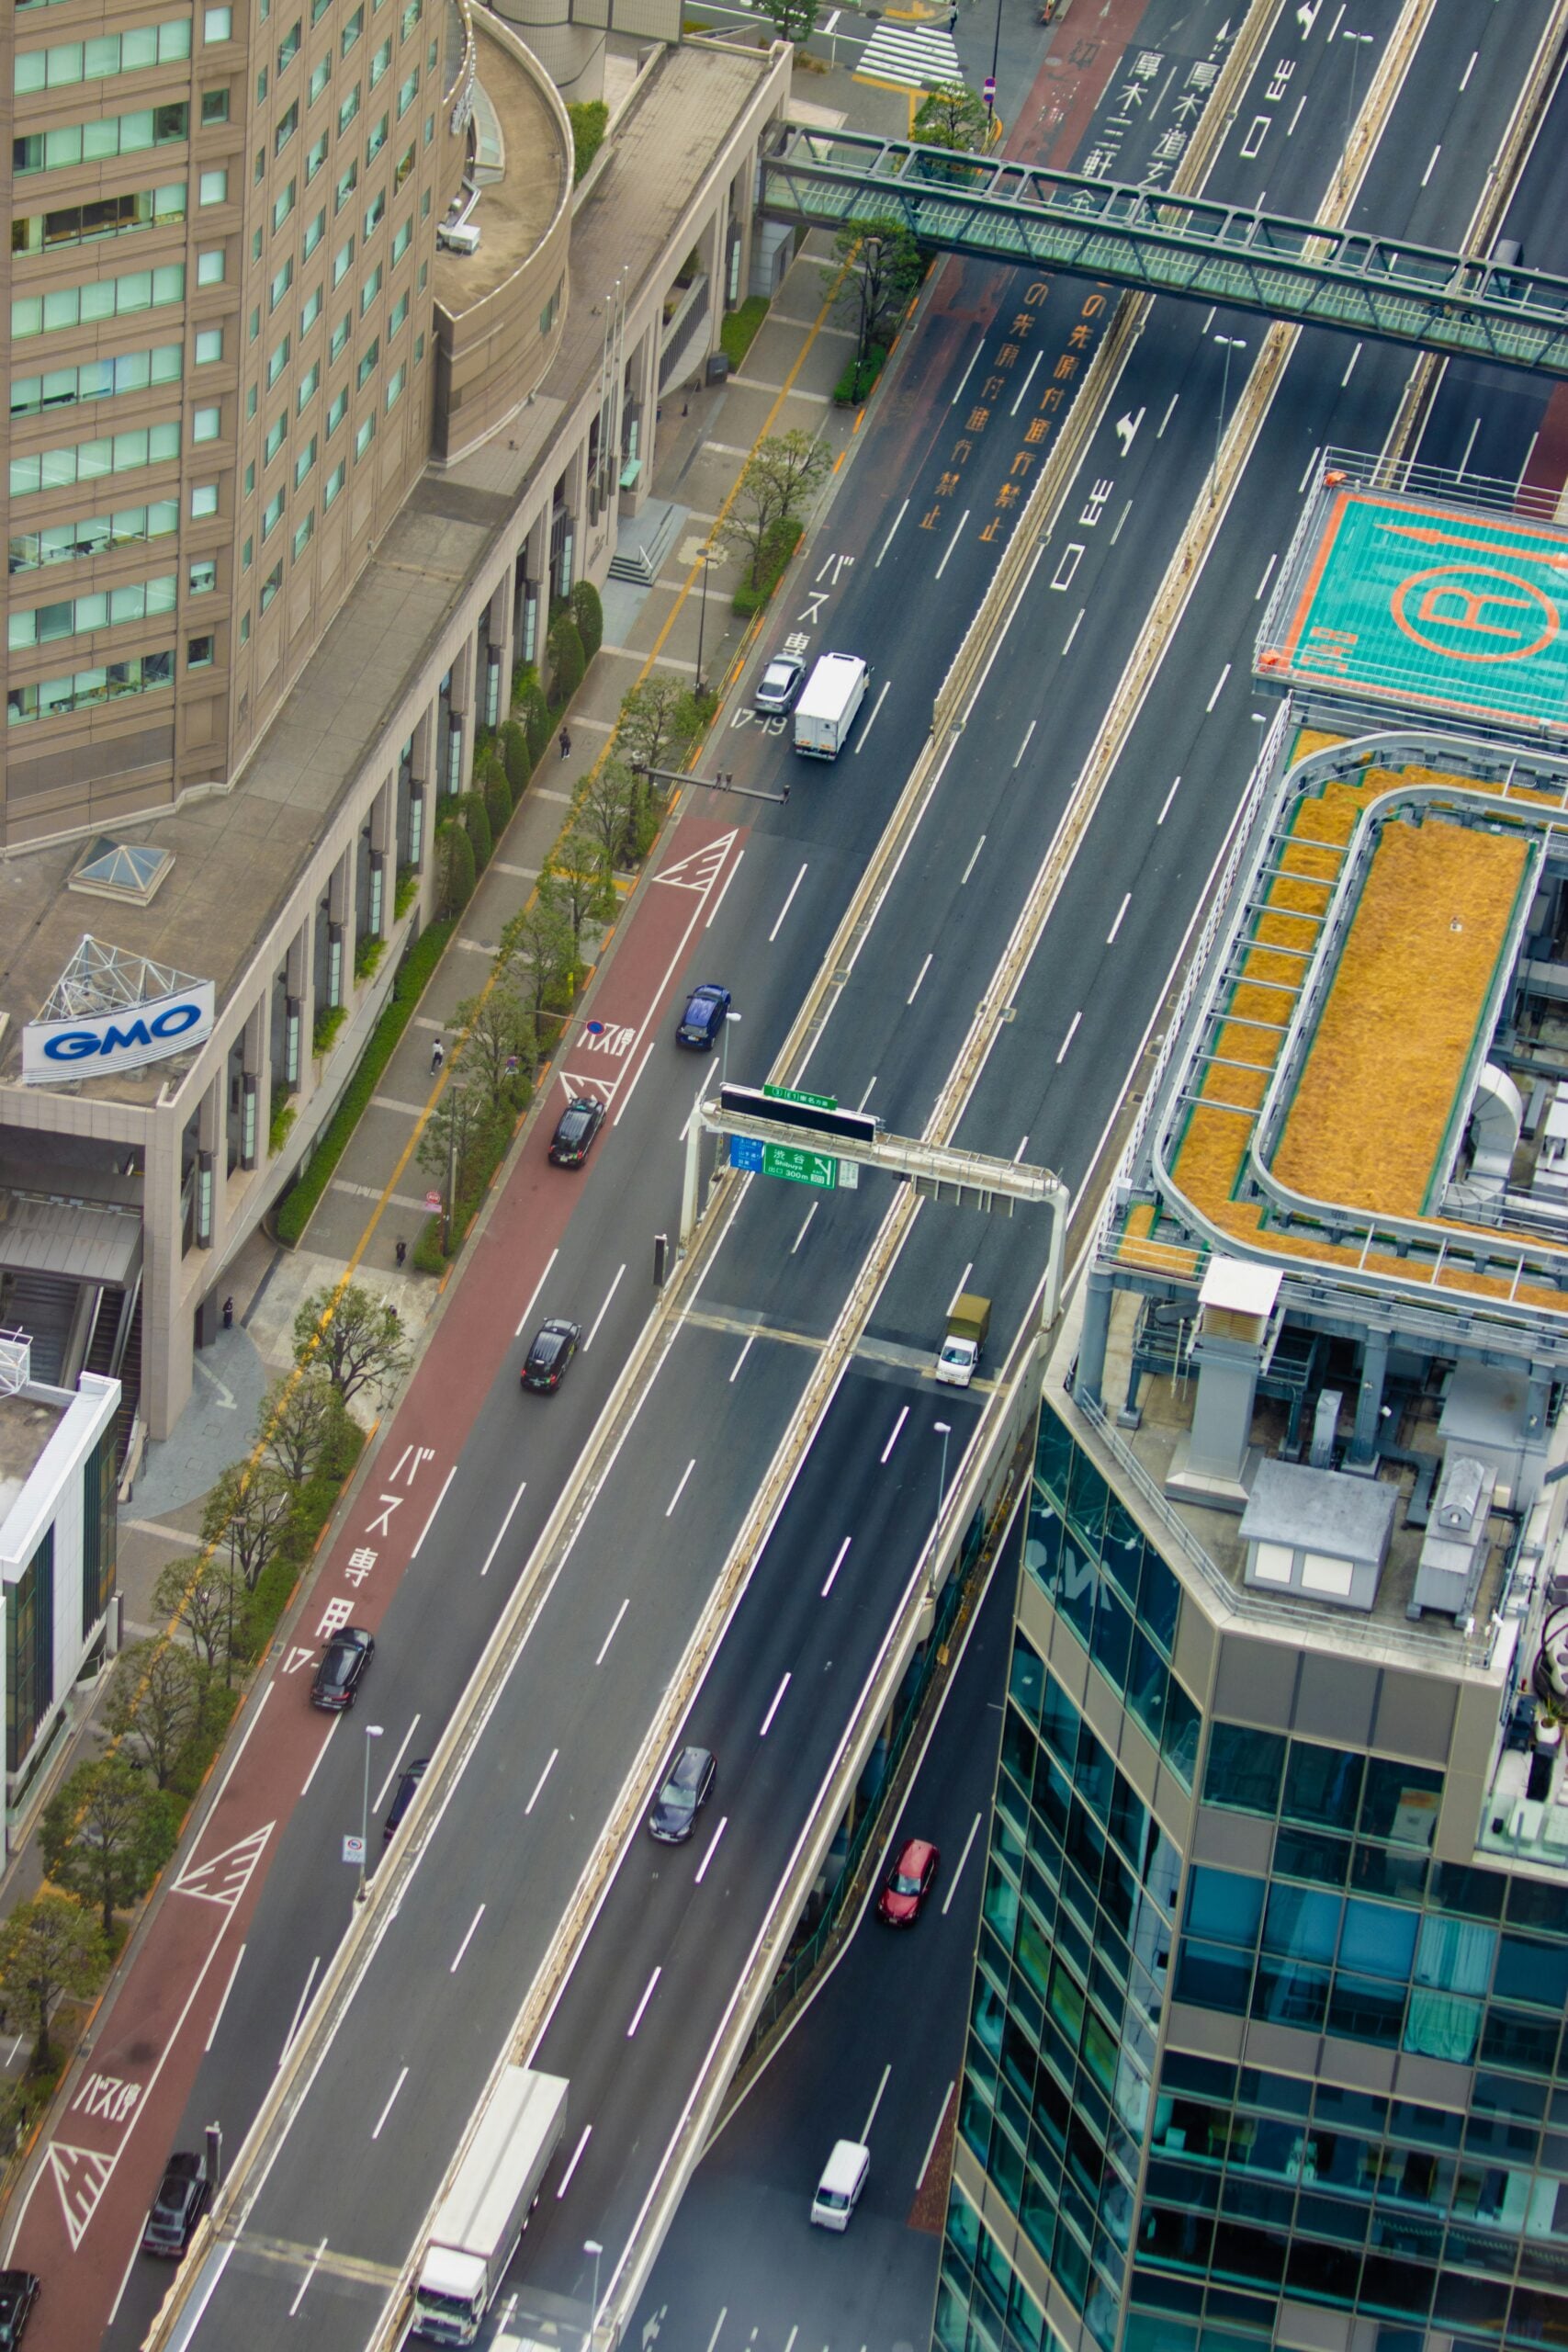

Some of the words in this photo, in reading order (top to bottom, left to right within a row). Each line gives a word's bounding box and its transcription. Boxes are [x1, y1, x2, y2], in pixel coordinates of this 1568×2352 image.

[1239, 59, 1296, 159] 出口
[919, 272, 1055, 530] の先原付通行禁止
[978, 282, 1113, 543] の先原付通行禁止
[1050, 479, 1114, 591] 出口
[730, 707, 788, 735] 17-19
[44, 1004, 201, 1060] GMO
[768, 1166, 784, 1175] 出口
[785, 1169, 808, 1181] 300m
[773, 1149, 805, 1165] 渋谷
[774, 1159, 803, 1171] Shibuya
[316, 1445, 435, 1639] バス専用
[71, 2073, 142, 2122] バス停
